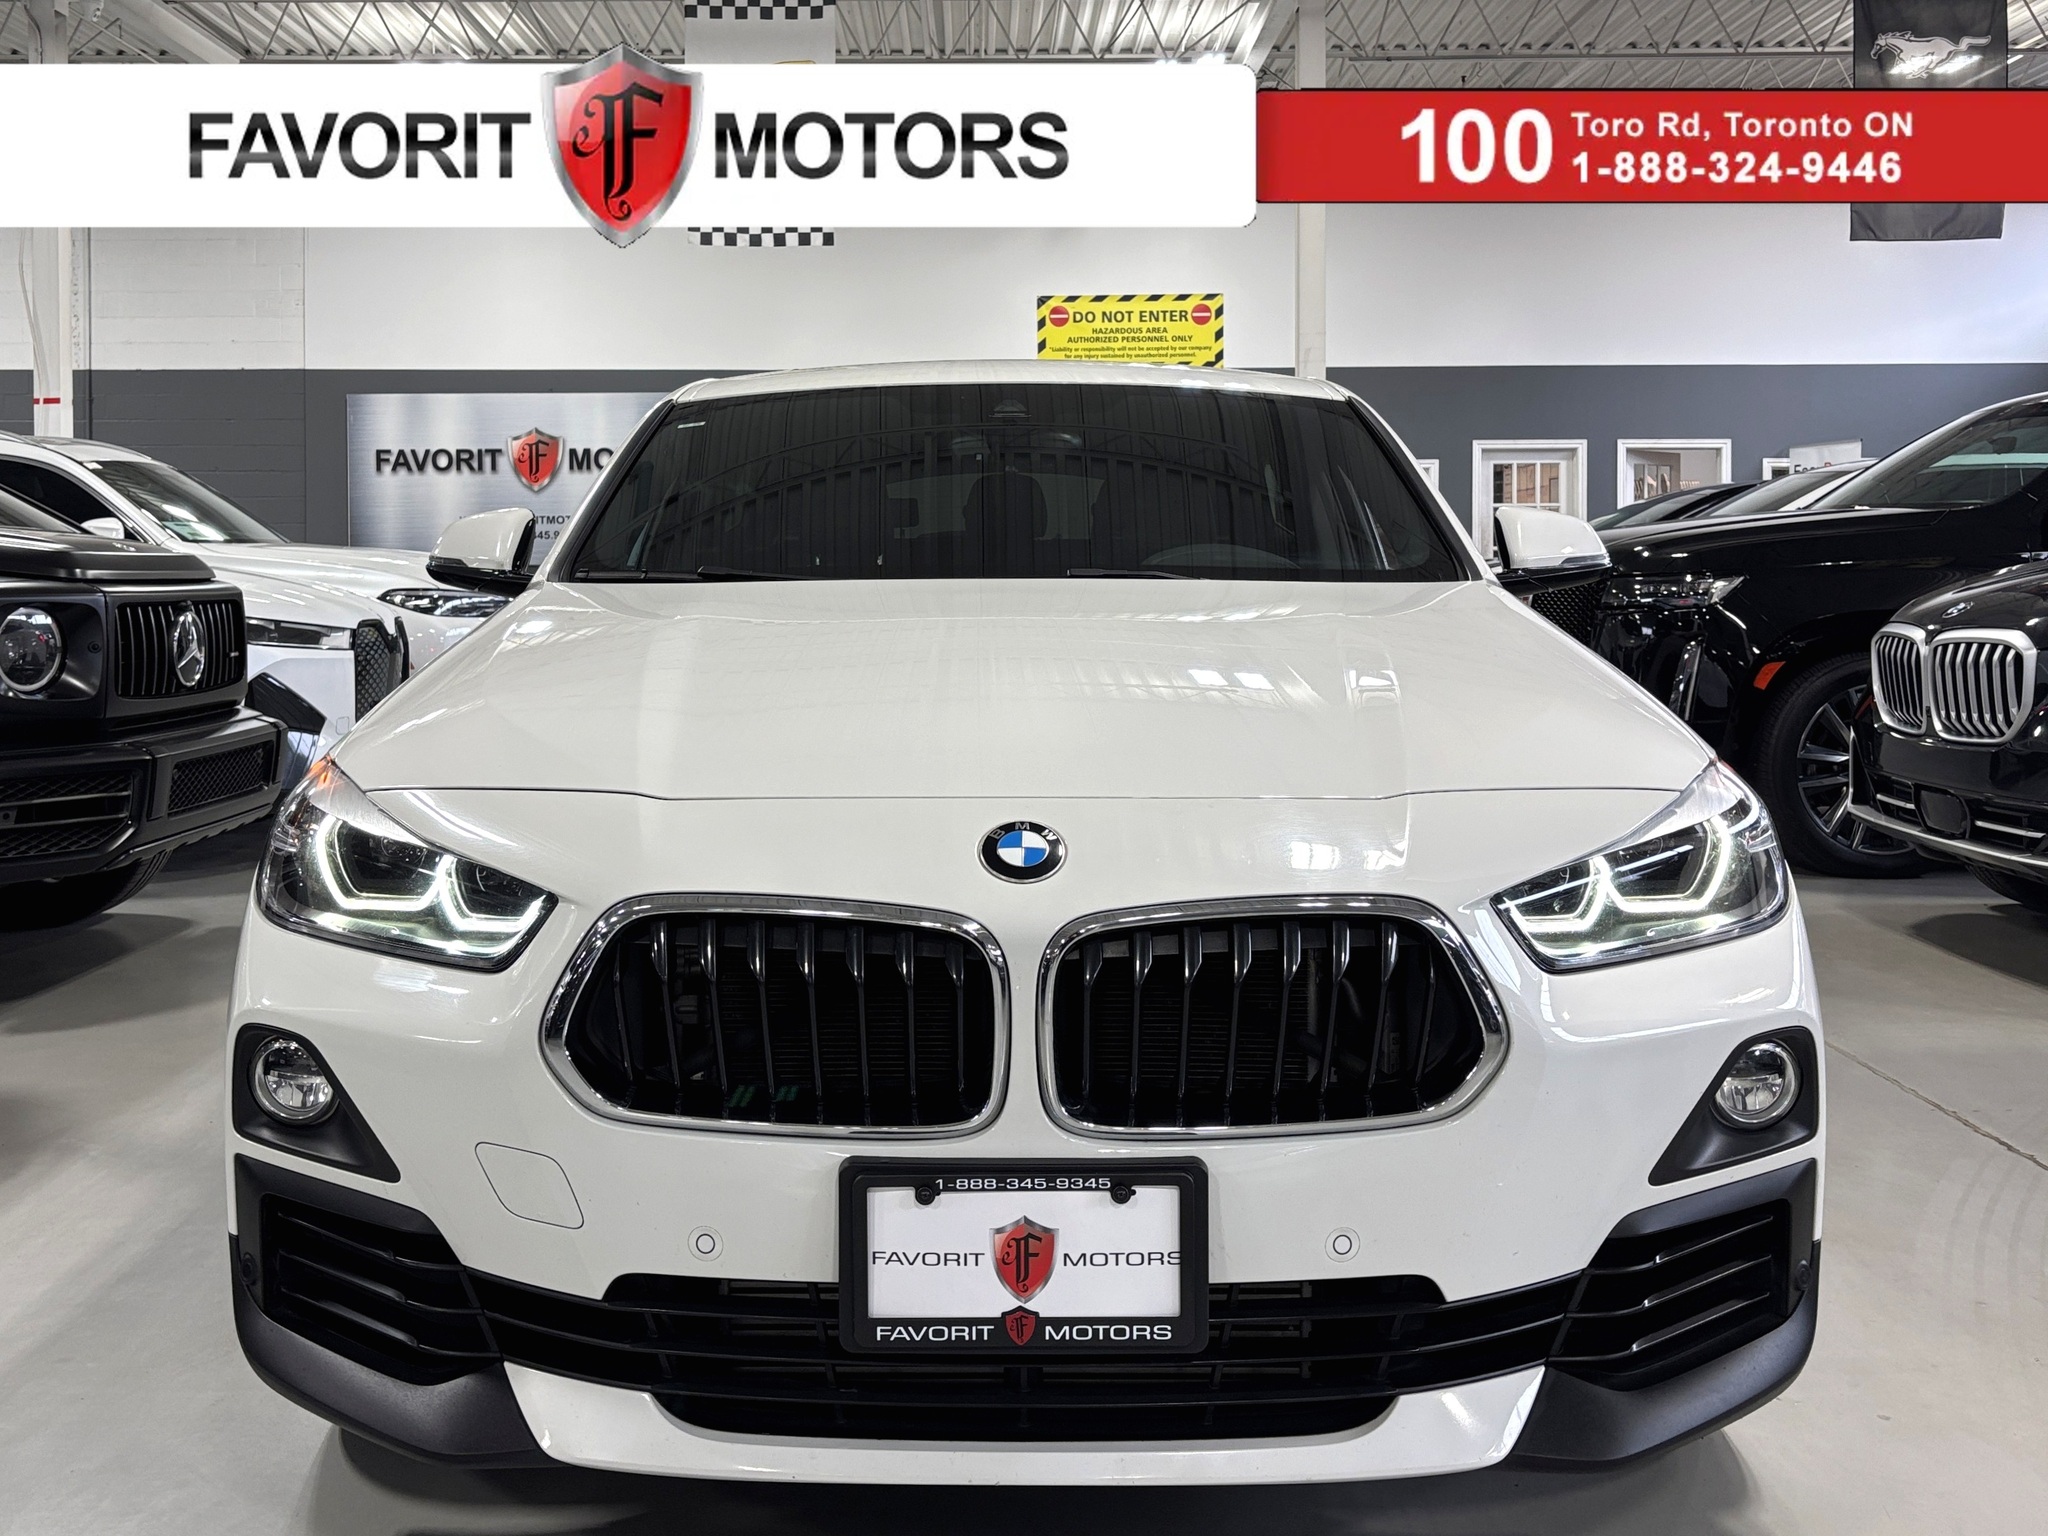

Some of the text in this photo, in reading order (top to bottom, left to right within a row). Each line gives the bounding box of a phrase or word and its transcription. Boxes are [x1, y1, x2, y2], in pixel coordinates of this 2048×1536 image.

[1073, 310, 1188, 323] DO NOT ENTER
[375, 449, 503, 472] FAVORIT
[989, 822, 1057, 841] BMW
[935, 1178, 1111, 1190] 1-888-345-9345
[872, 1251, 985, 1265] FAVORIT
[1063, 1251, 1181, 1266] MOTORS
[876, 1326, 994, 1341] FAVORIT
[1045, 1325, 1172, 1340] MOTORS
